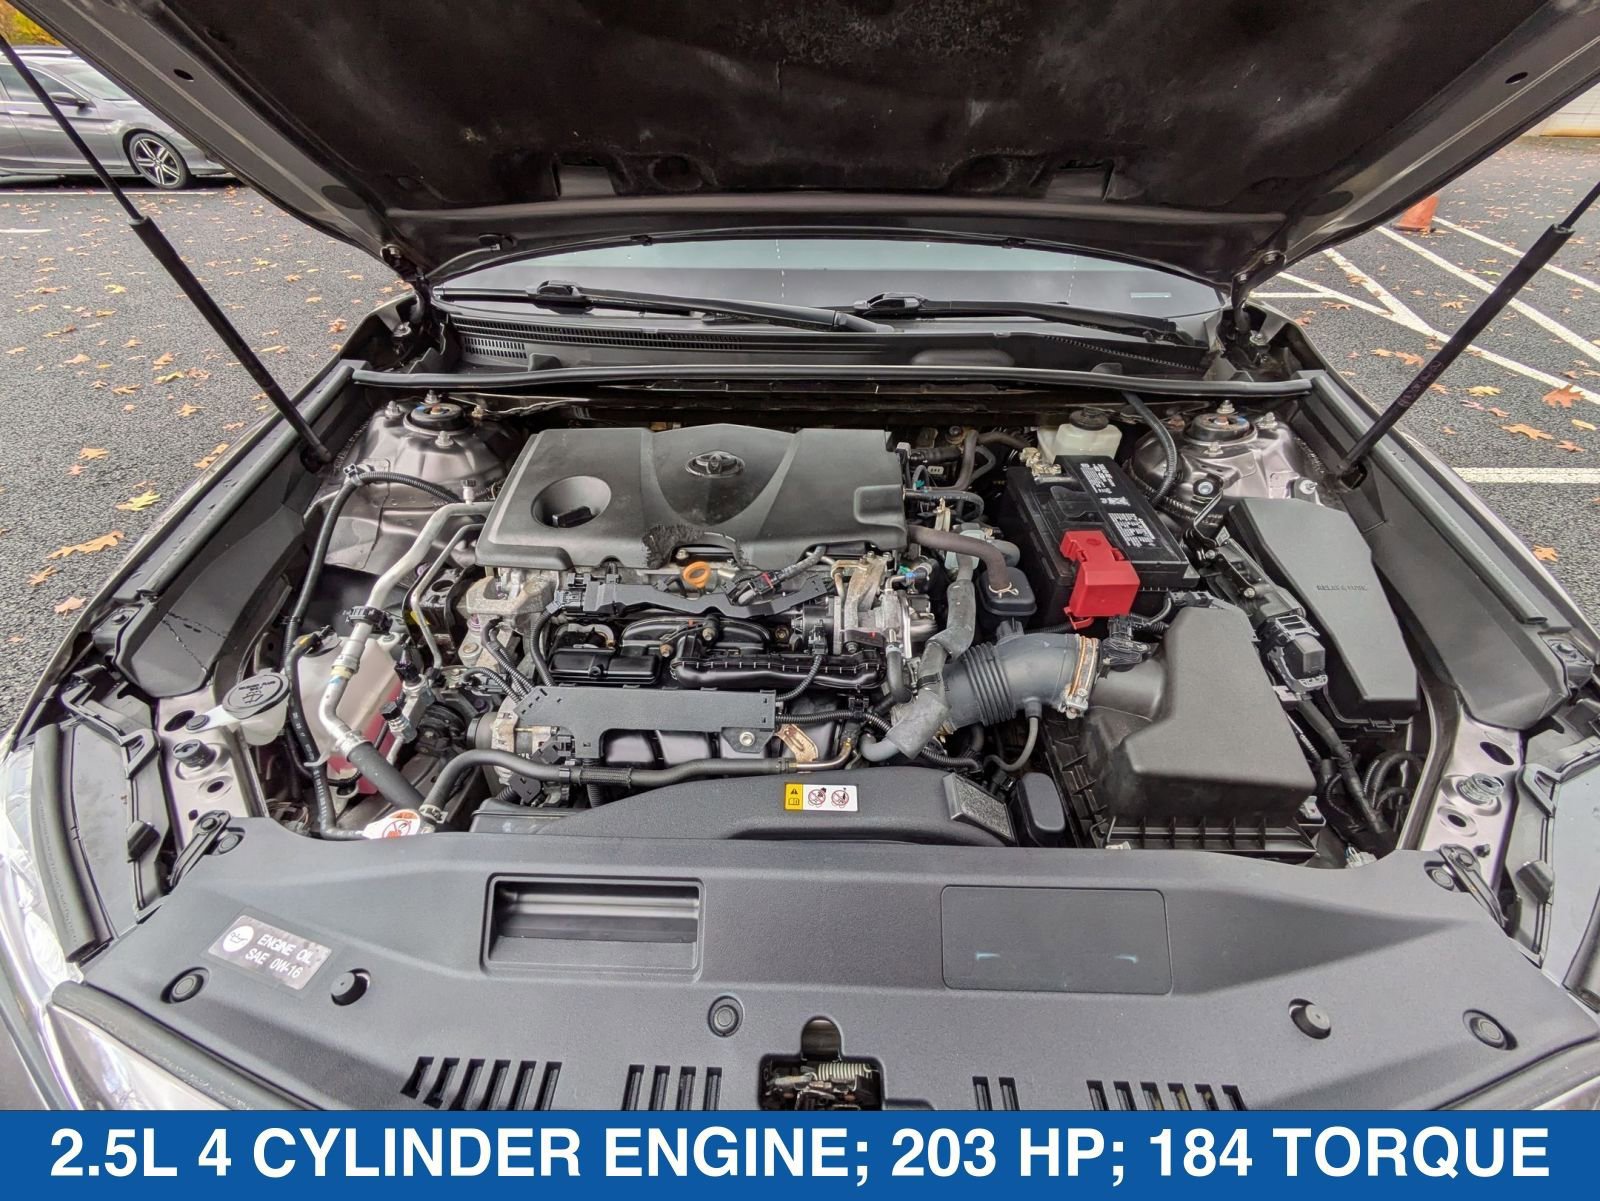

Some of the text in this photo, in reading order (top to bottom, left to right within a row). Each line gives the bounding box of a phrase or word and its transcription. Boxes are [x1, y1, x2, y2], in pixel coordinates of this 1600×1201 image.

[244, 948, 304, 979] SAE 0W-16
[257, 933, 315, 965] ENGINE OIL
